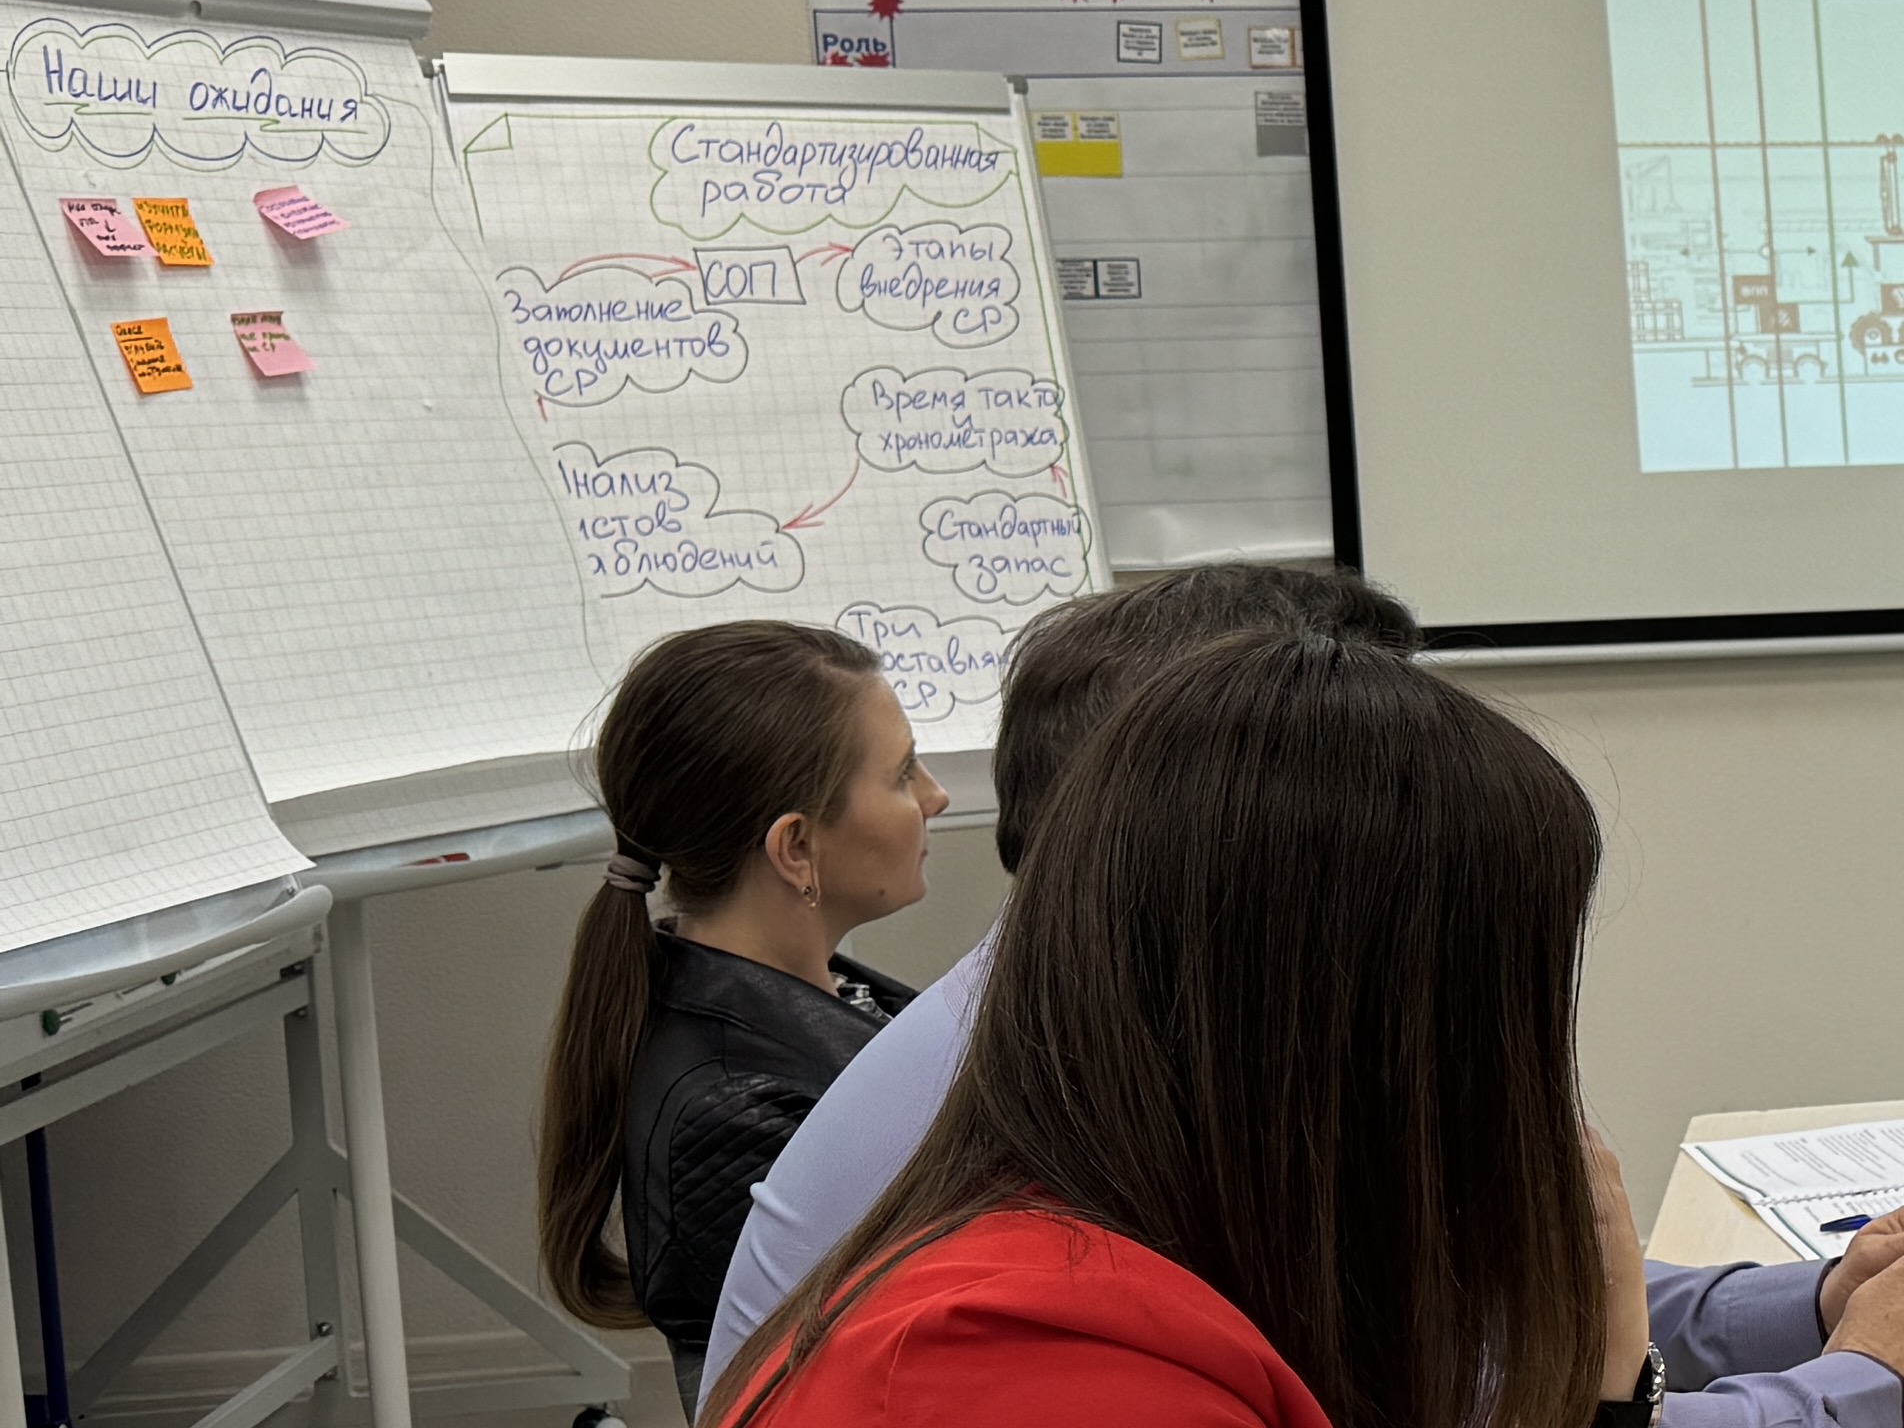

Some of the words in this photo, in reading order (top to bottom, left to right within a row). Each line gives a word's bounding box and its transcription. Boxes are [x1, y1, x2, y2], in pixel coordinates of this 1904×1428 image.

[822, 32, 888, 54] Роль
[43, 44, 158, 108] Наши
[188, 68, 360, 121] ожидания
[670, 121, 1000, 185] Стандартизированная
[701, 170, 848, 218] работа
[884, 235, 995, 263] Этапы
[705, 263, 779, 299] СОП
[859, 257, 1001, 313] внедрения
[506, 288, 692, 326] Заполнение
[952, 307, 1002, 334] СР
[523, 323, 731, 374] документов
[544, 370, 599, 405] СР
[873, 380, 966, 420] Время
[983, 381, 1061, 410] такта
[881, 424, 1060, 467] хронометража
[936, 500, 1082, 549] Стандартный
[968, 550, 1074, 592] запас
[847, 610, 922, 649] Три
